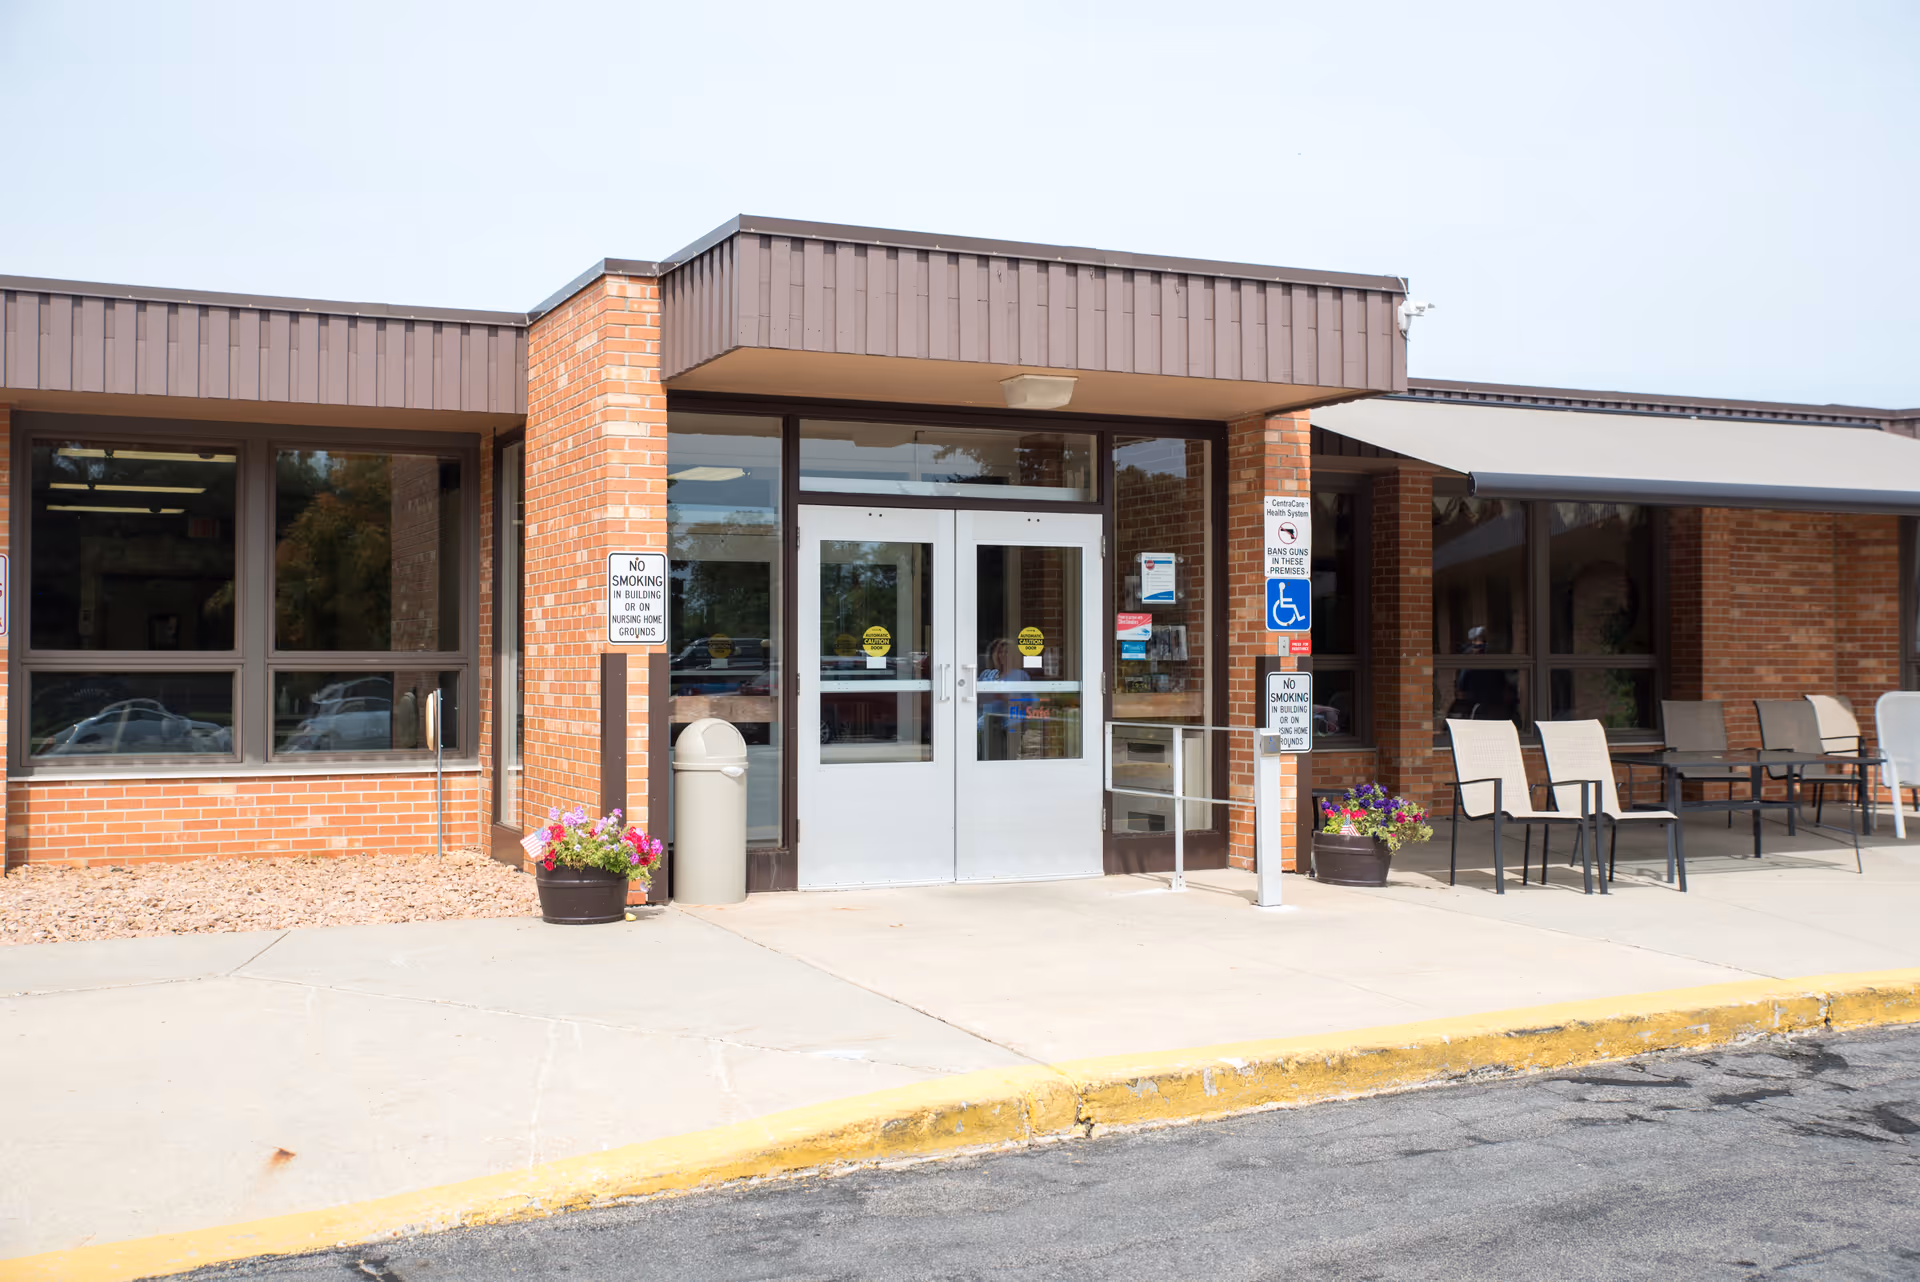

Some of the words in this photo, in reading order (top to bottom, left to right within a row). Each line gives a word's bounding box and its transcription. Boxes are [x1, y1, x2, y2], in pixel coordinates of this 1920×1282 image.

[1272, 499, 1304, 508] CentraCare
[1266, 508, 1286, 517] Health
[1287, 509, 1309, 518] System
[1267, 547, 1287, 556] BANS
[1289, 548, 1309, 556] GUNS
[1272, 557, 1279, 565] IN
[1281, 557, 1303, 565] THESE
[629, 560, 645, 572] NO
[1270, 566, 1305, 575] PREMISES
[612, 575, 663, 587] SMOKING
[613, 590, 621, 599] IN
[625, 590, 661, 599] BUILDING
[624, 602, 636, 611] OR
[639, 602, 650, 611] ON
[612, 615, 641, 624] NURSING
[643, 615, 662, 624] HOME
[619, 627, 656, 637] GROUNDS
[1283, 679, 1296, 690] NO
[1270, 692, 1309, 703] SMOKING
[1271, 705, 1278, 713] IN
[1280, 705, 1308, 714] BUILDING
[1279, 716, 1289, 724] OR
[1290, 716, 1300, 724] ON
[1293, 726, 1309, 735] HOME
[1280, 737, 1304, 746] ROUNDS
